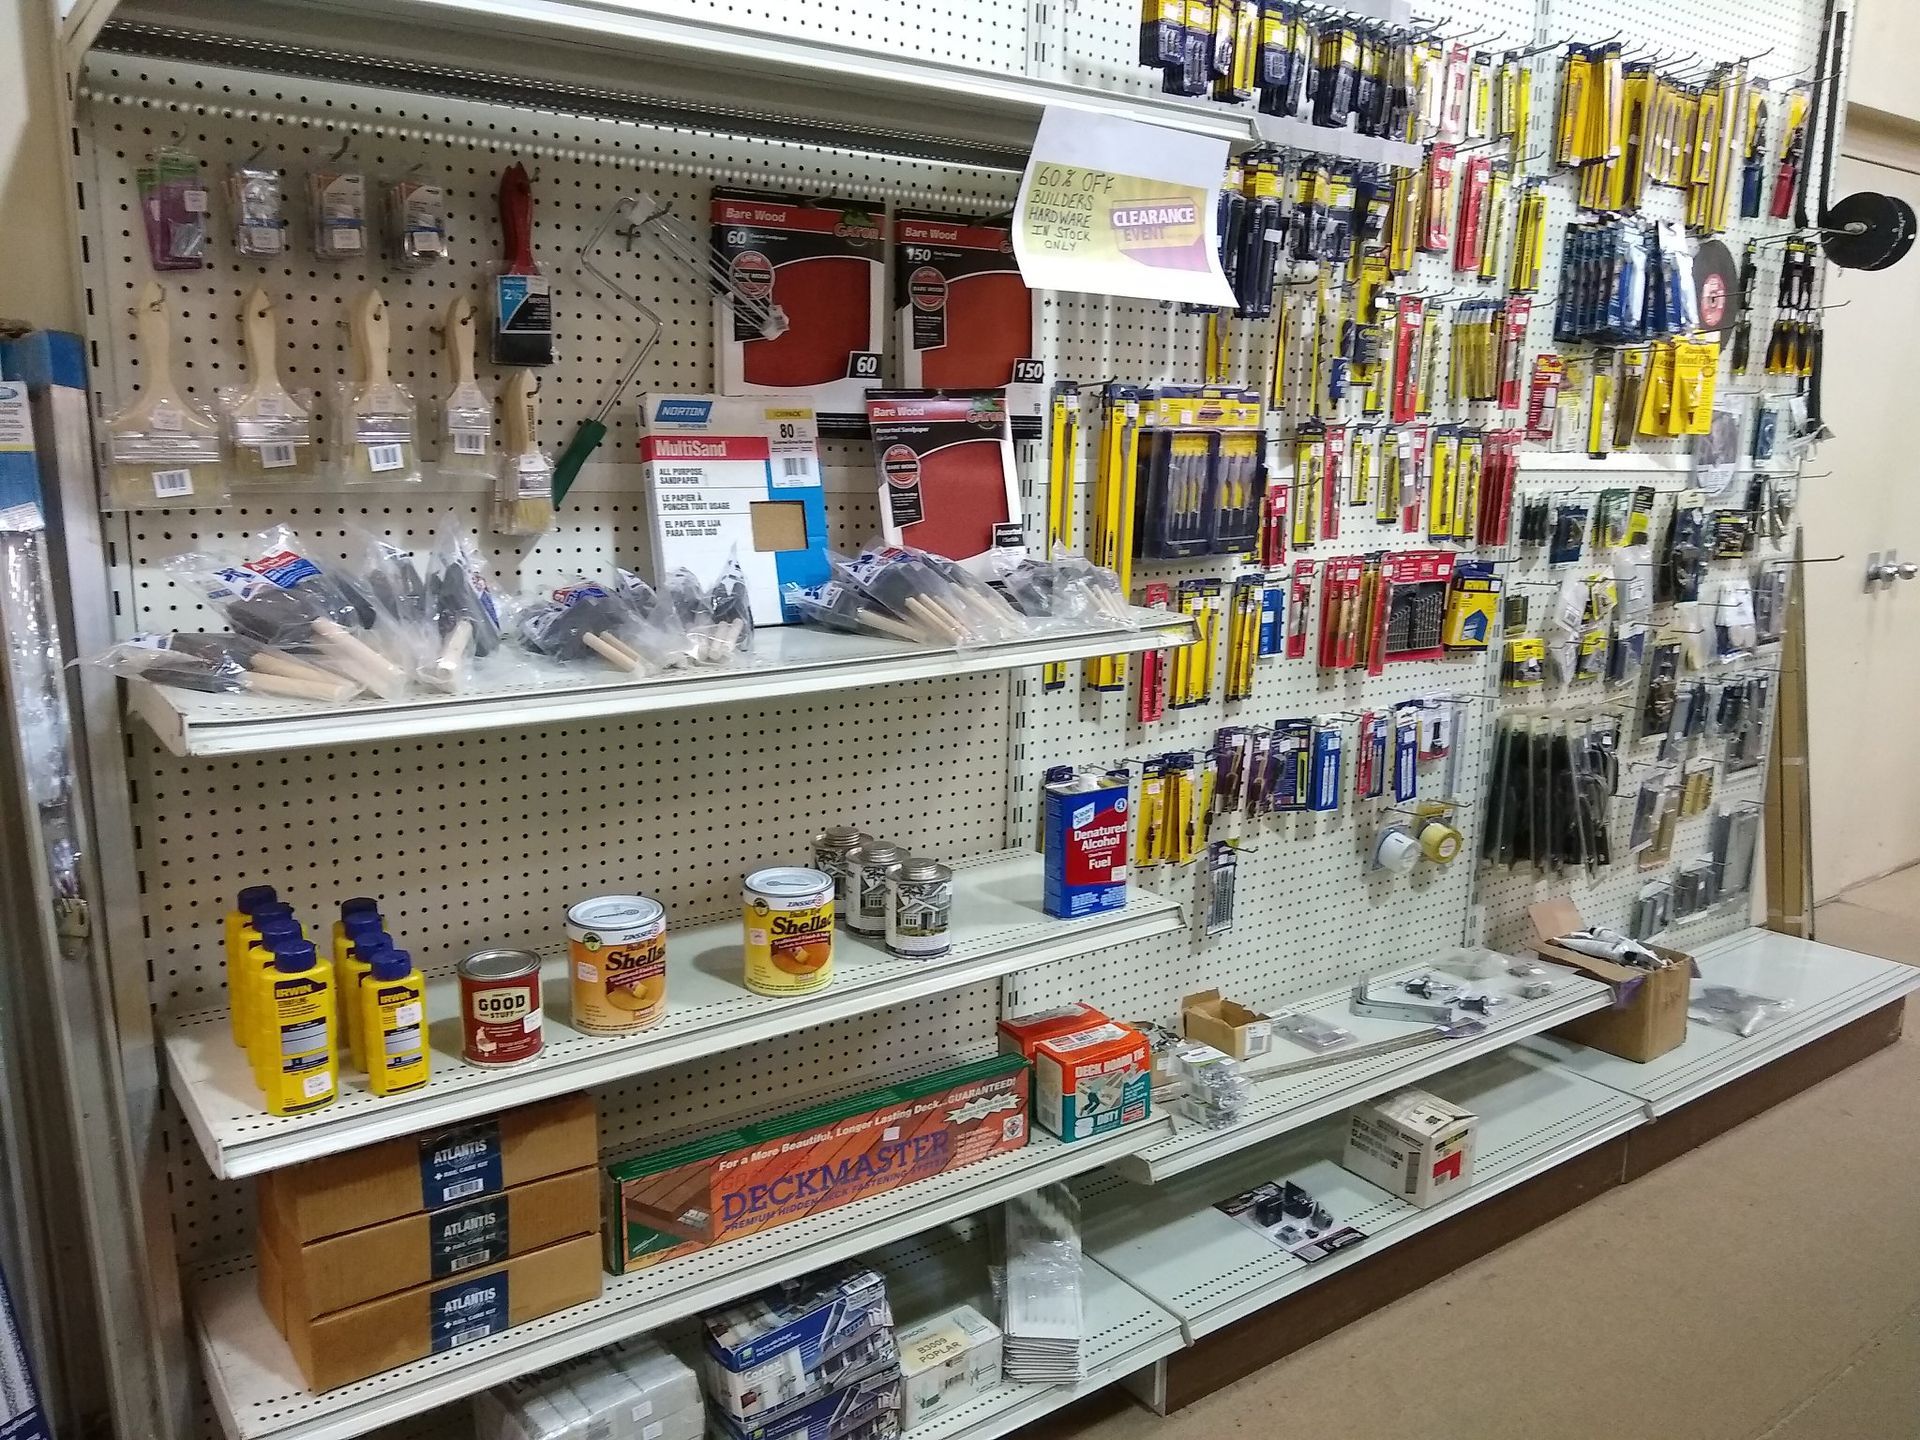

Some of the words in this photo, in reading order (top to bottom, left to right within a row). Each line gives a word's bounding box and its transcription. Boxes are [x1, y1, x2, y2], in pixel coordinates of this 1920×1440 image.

[1038, 167, 1075, 187] 60%
[1082, 172, 1115, 194] OFF
[1031, 189, 1094, 211] BUILDERS
[726, 207, 752, 221] Bare
[754, 210, 787, 222] Wood
[1029, 207, 1092, 228] HARDWARE
[1113, 207, 1194, 226] CLEARANCE
[727, 230, 747, 245] 60
[905, 227, 927, 238] Bare
[930, 229, 957, 240] Wood
[1032, 225, 1049, 236] IN
[1056, 227, 1091, 241] STOCK
[1124, 226, 1164, 241] EVENT
[1045, 239, 1077, 252] ONLY
[906, 247, 932, 261] 150
[856, 356, 878, 373] 60
[1017, 363, 1043, 379] 150
[661, 406, 705, 417] NORTON
[873, 407, 896, 416] Bare
[898, 406, 924, 416] Wood
[780, 424, 794, 438] 80
[655, 440, 727, 457] MultiSand
[660, 476, 699, 485] SANDPAPER
[662, 494, 671, 502] LE
[663, 503, 689, 511] PONCER
[708, 502, 730, 510] USAGE
[666, 529, 684, 537] PARA
[1074, 821, 1127, 841] Denatured
[1081, 834, 1120, 851] Alcohol
[1089, 856, 1111, 870] Fuel
[276, 984, 312, 998] IRWIN
[380, 992, 411, 1003] IRWIN
[479, 995, 525, 1011] GOOD
[490, 1011, 514, 1019] STUFF
[1075, 1062, 1103, 1078] DECK
[1103, 1053, 1133, 1071] BOARD
[1133, 1047, 1146, 1061] TIE
[719, 1158, 739, 1171] For
[740, 1157, 748, 1165] a
[751, 1148, 780, 1162] More
[781, 1132, 834, 1154] Beautiful,
[836, 1120, 873, 1137] Longer
[875, 1108, 912, 1125] Lasting
[434, 1140, 487, 1164] ATLANTIS
[459, 1163, 476, 1173] CARE
[721, 1129, 948, 1222] DECKMASTER
[725, 1212, 776, 1231] PREMIUM
[778, 1199, 819, 1217] HIDDEN
[852, 1171, 907, 1193] FASTENING
[444, 1212, 496, 1237] ATLANTIS
[444, 1287, 496, 1313] ATLANTIS
[917, 1337, 948, 1354] B3009
[919, 1341, 961, 1363] POPLAR
[745, 1360, 782, 1381] Cortex
